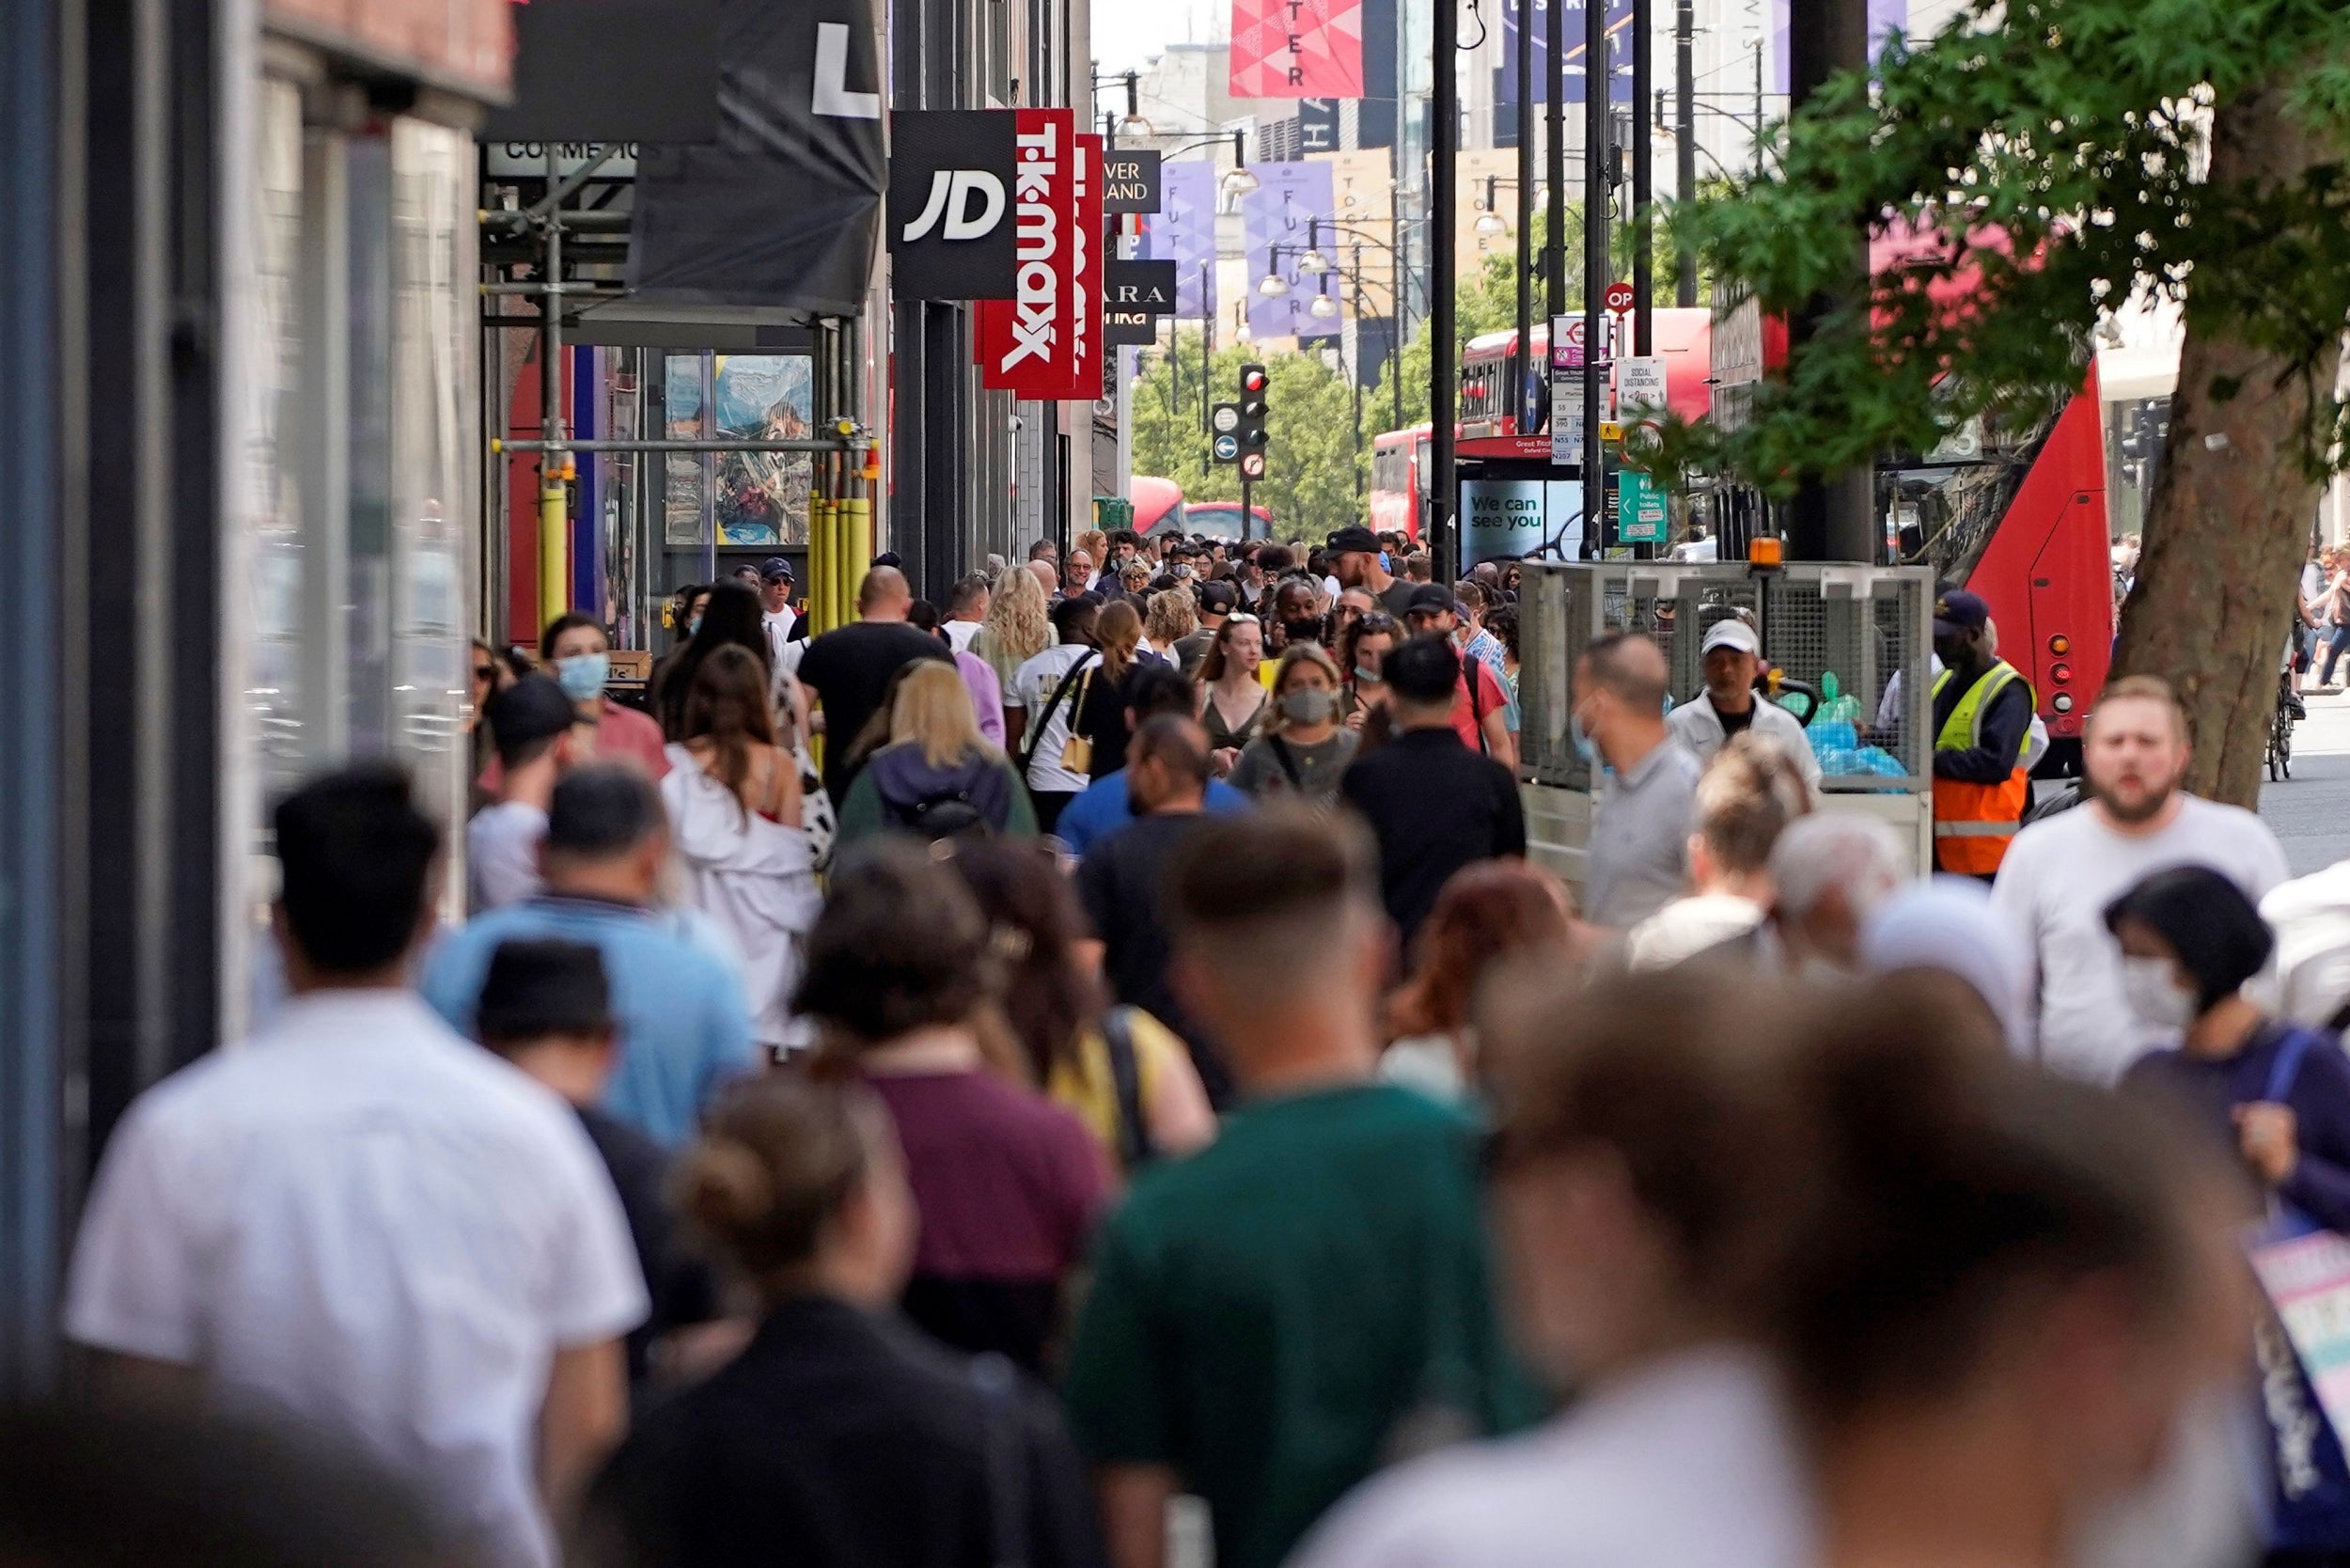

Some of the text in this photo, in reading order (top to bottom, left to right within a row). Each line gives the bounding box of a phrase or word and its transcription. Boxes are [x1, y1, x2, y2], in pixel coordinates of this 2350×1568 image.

[1104, 163, 1139, 180] VER
[1104, 183, 1148, 200] AND
[902, 169, 1007, 243] JD
[1104, 285, 1167, 303] RA
[1608, 292, 1633, 306] OP
[1631, 368, 1652, 377] SOCIAL
[1623, 377, 1659, 387] DISTANCING
[1471, 496, 1536, 510] We can
[1471, 515, 1541, 531] see you
